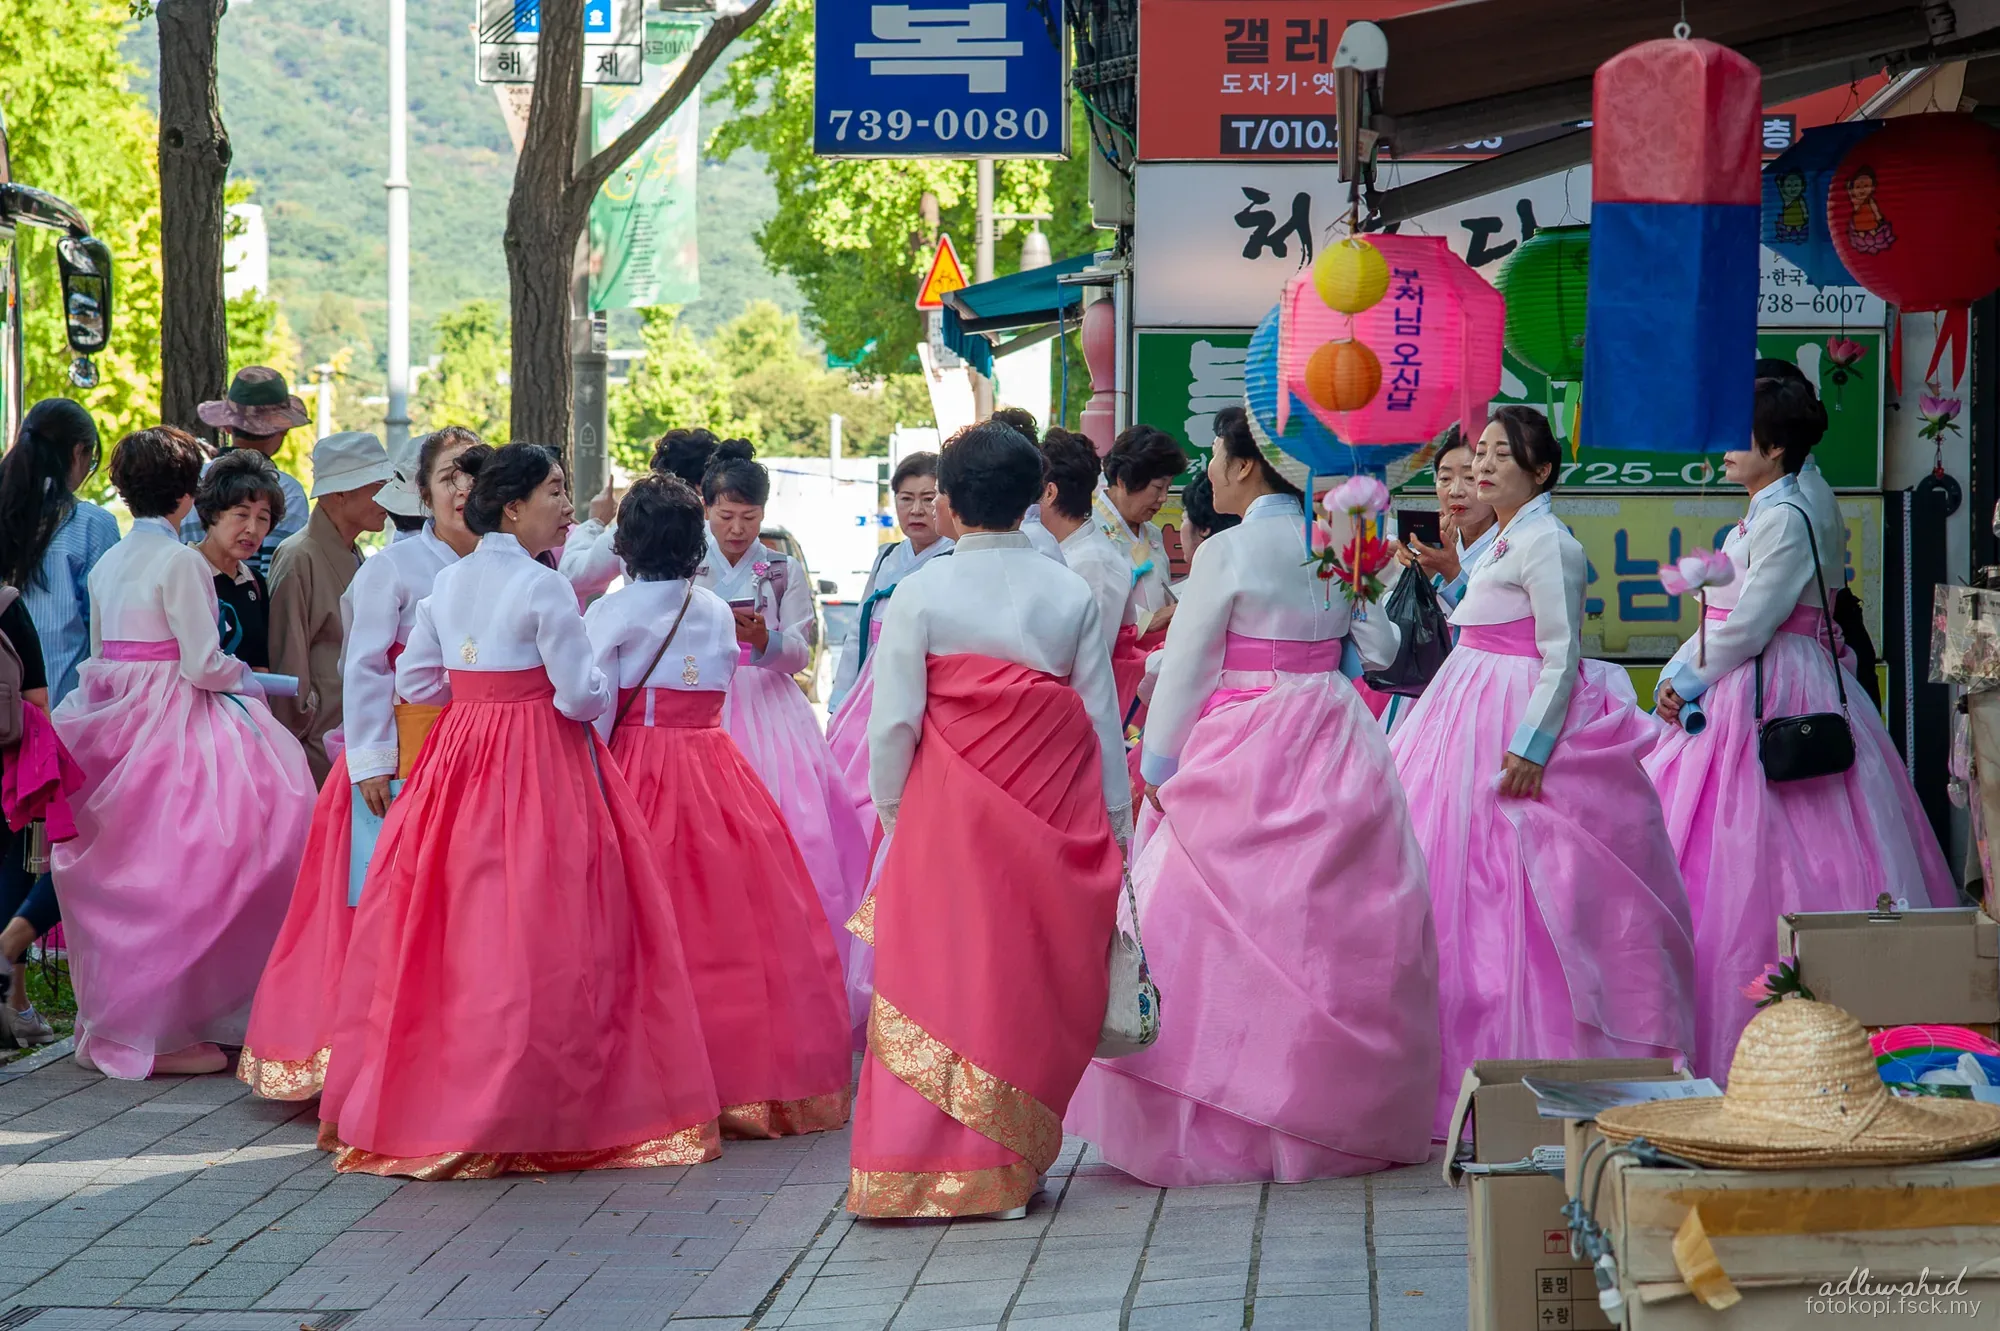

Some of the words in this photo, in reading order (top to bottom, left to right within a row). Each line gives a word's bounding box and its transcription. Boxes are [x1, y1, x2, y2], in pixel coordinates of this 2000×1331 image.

[854, 3, 1024, 93] 복
[1224, 18, 1374, 64] 갤러
[828, 107, 1049, 142] 739-0080
